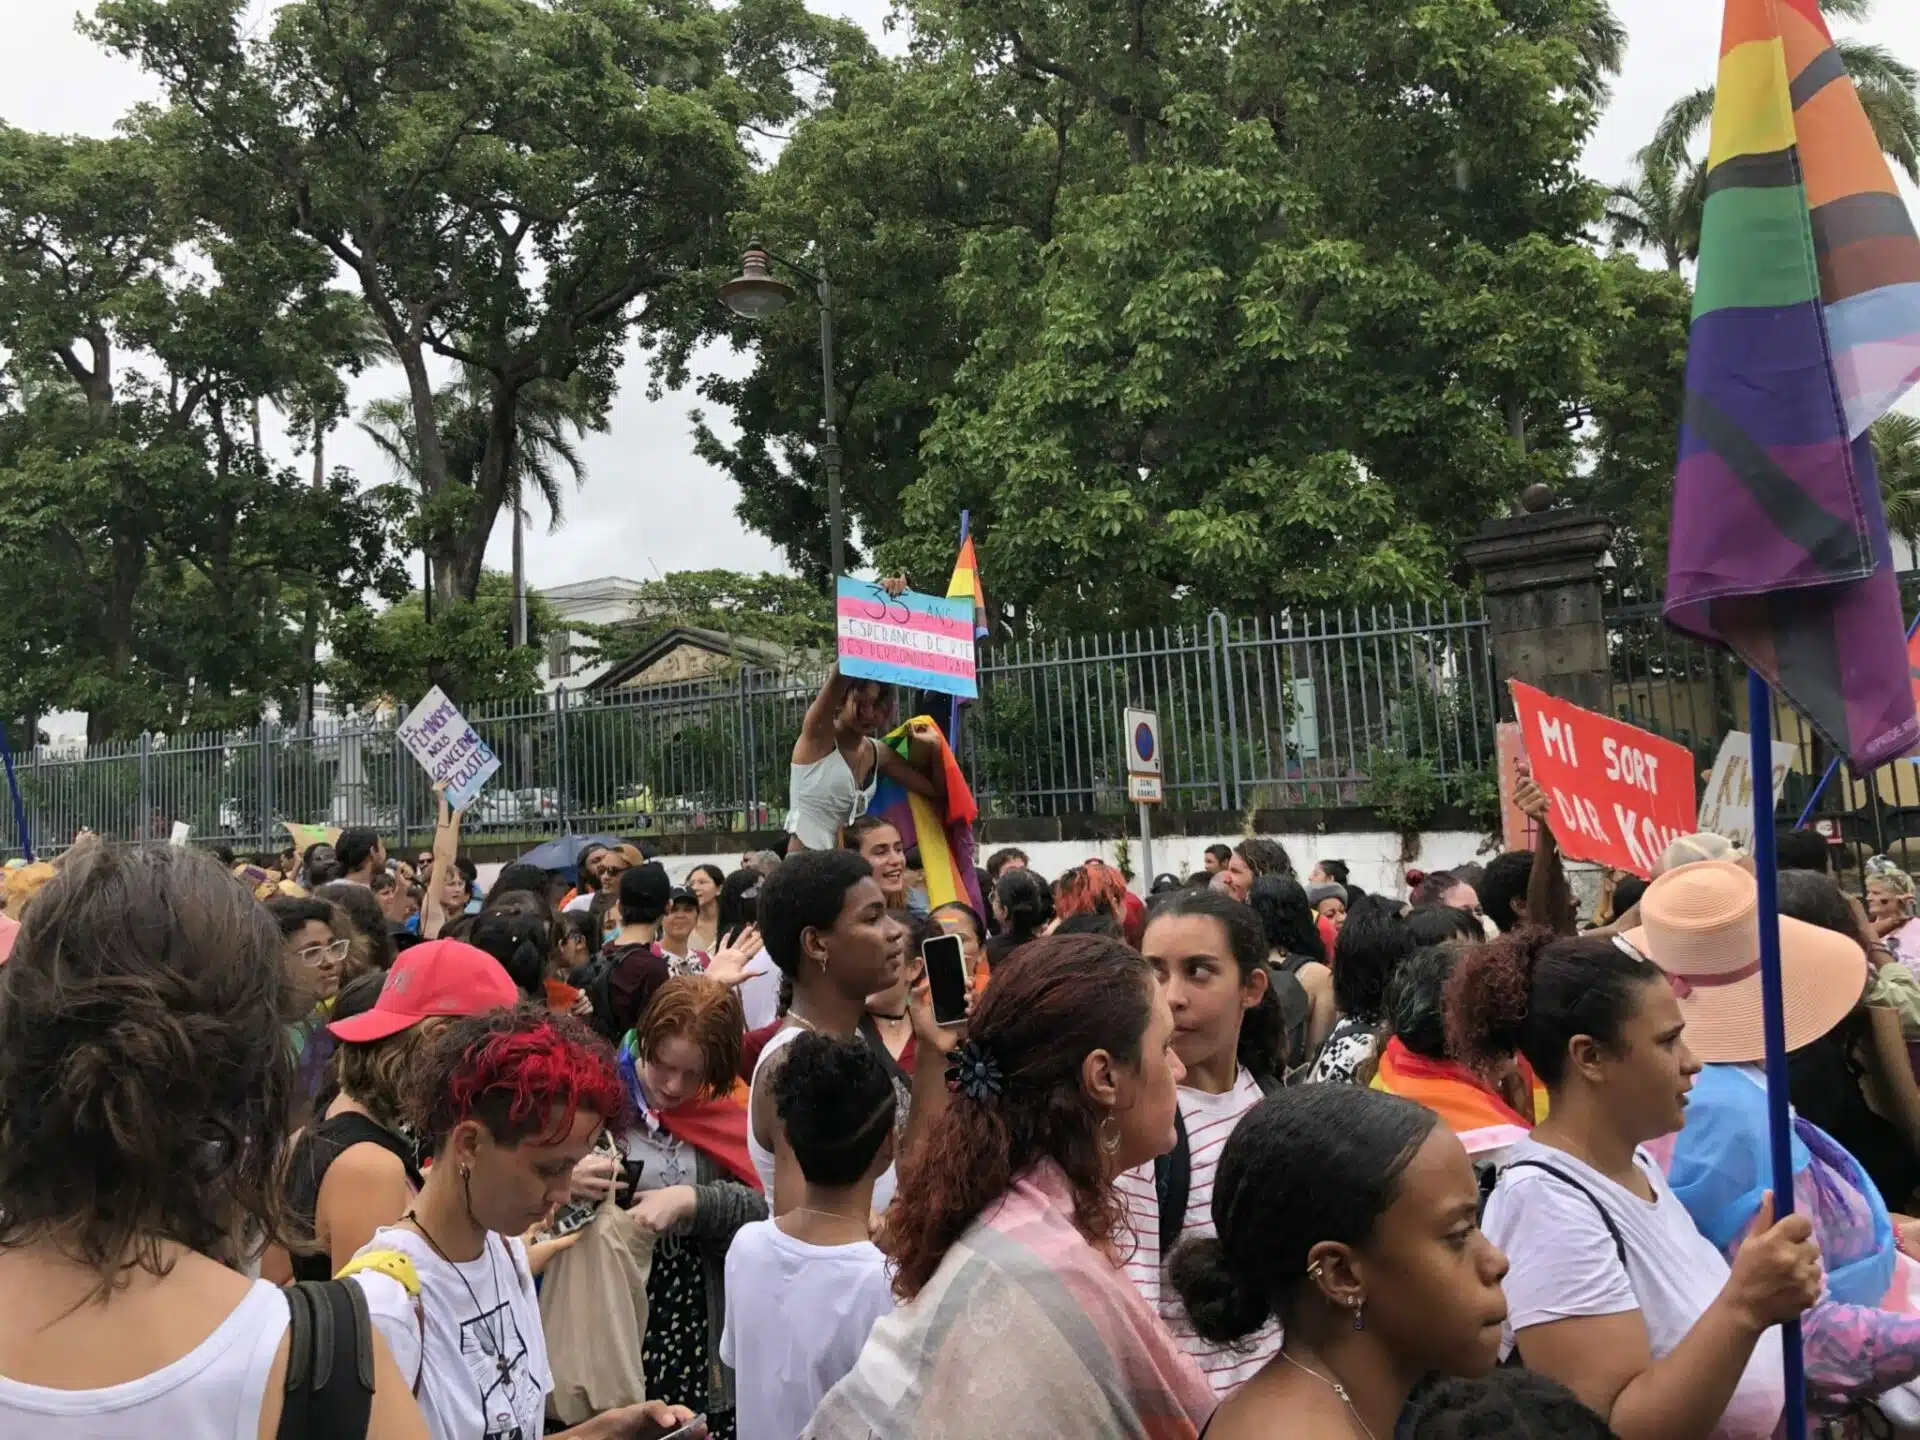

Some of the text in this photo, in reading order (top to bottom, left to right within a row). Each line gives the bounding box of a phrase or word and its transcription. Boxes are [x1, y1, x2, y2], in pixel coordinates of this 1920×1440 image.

[863, 584, 954, 629] 35 ANS
[927, 635, 944, 653] DE
[427, 733, 451, 758] NOUS
[432, 727, 479, 781] CONCERNE
[1537, 710, 1579, 769] MI
[1602, 736, 1658, 796] SORT
[1552, 786, 1612, 846] DAR
